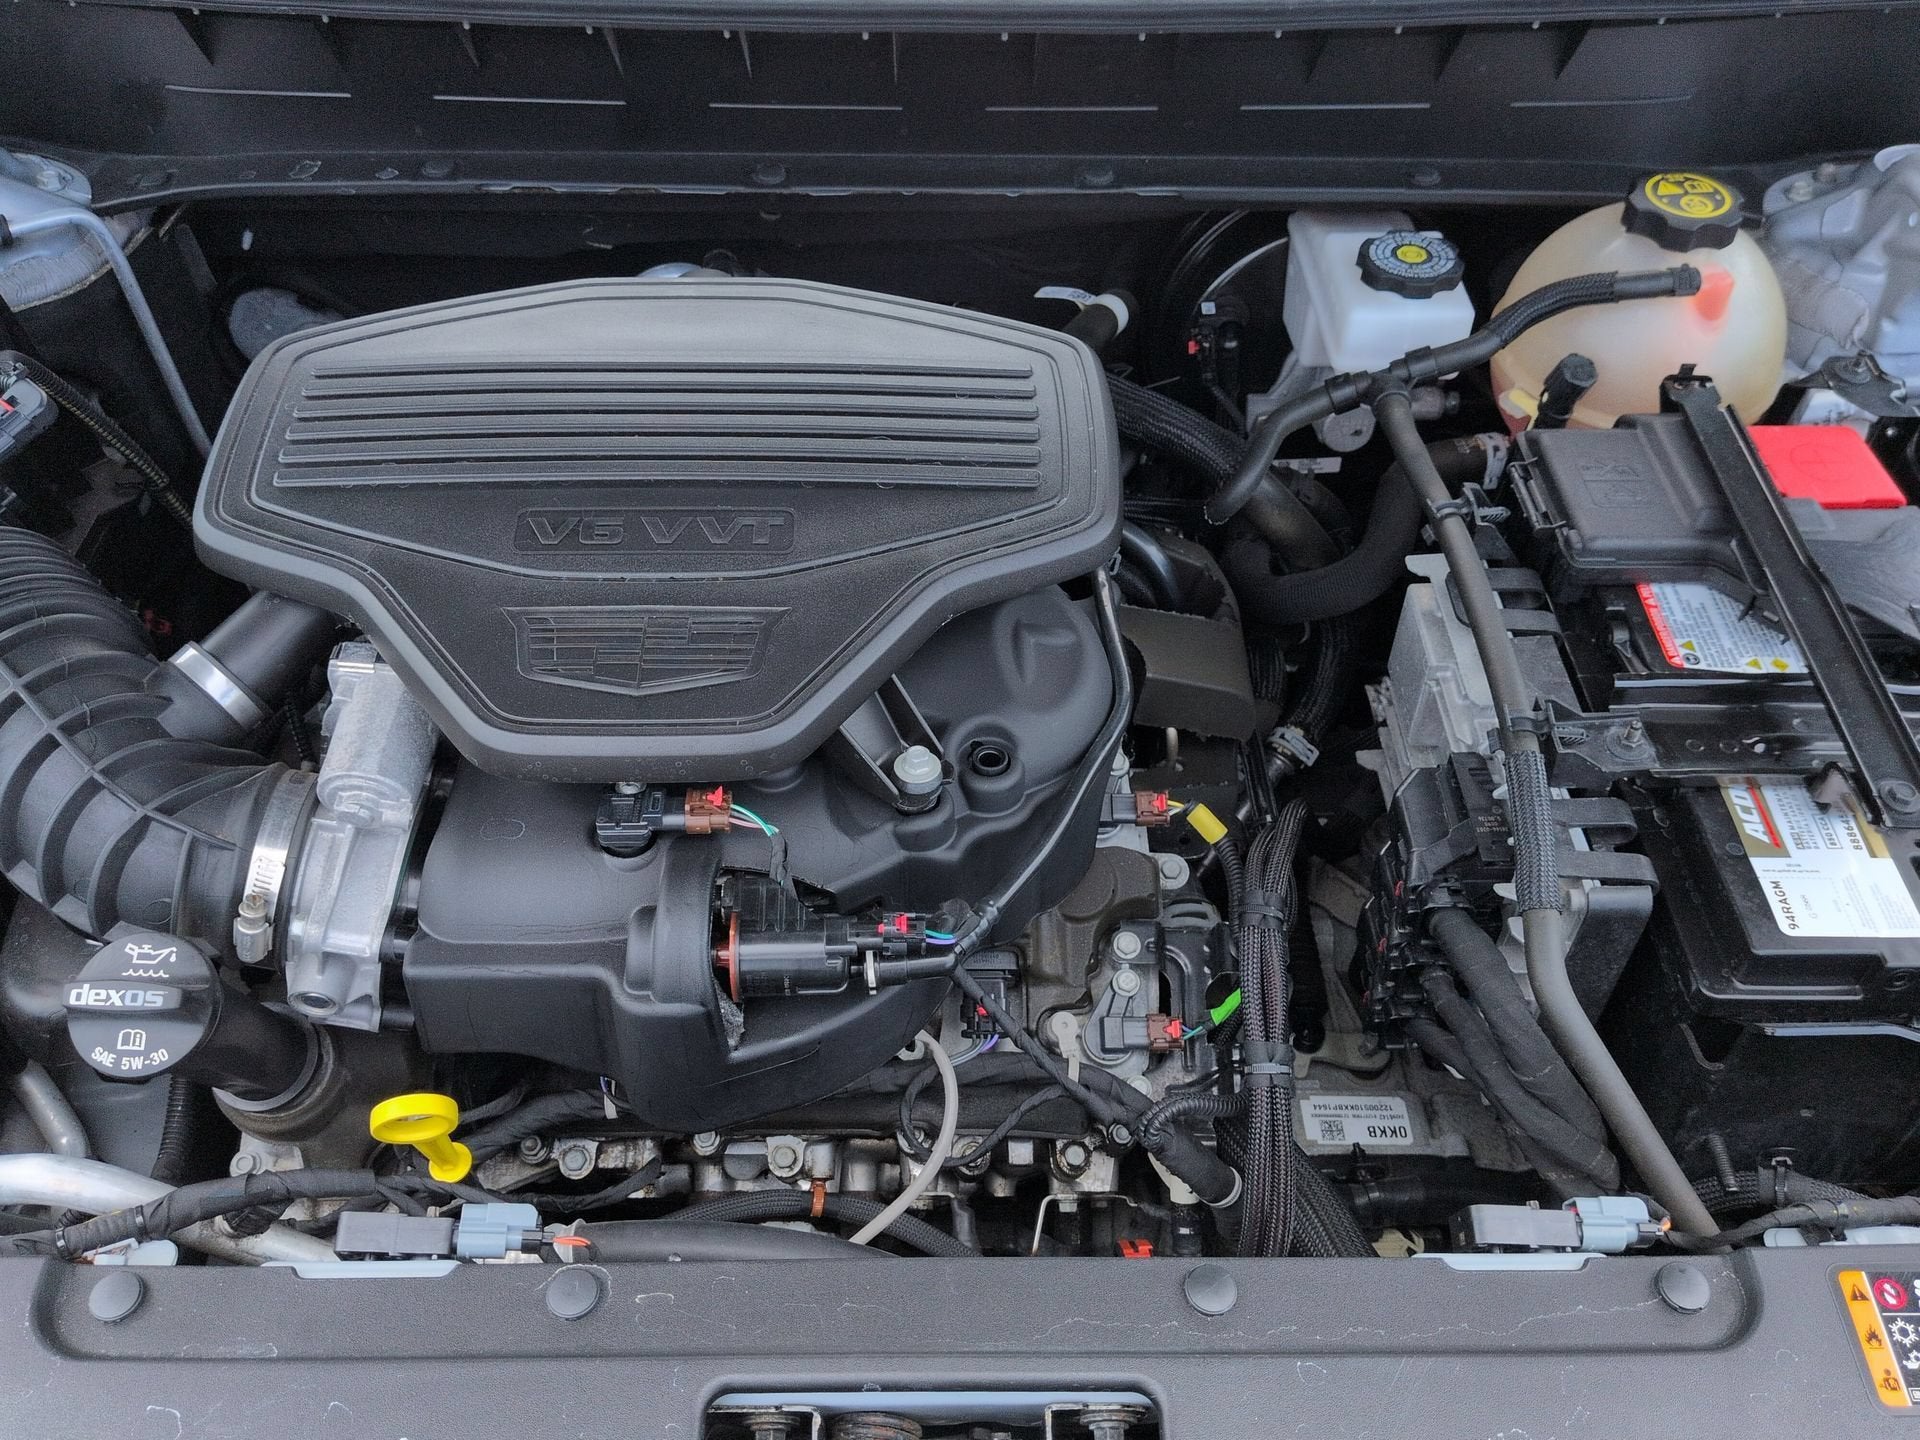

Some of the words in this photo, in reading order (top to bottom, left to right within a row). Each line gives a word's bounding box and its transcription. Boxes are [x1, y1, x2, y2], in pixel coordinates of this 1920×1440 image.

[528, 516, 625, 544] V6
[640, 516, 785, 544] VVT
[1769, 880, 1800, 930] 94RAGM
[69, 984, 164, 1007] dexos
[91, 1046, 117, 1067] SAE
[121, 1048, 169, 1070] 5W-30
